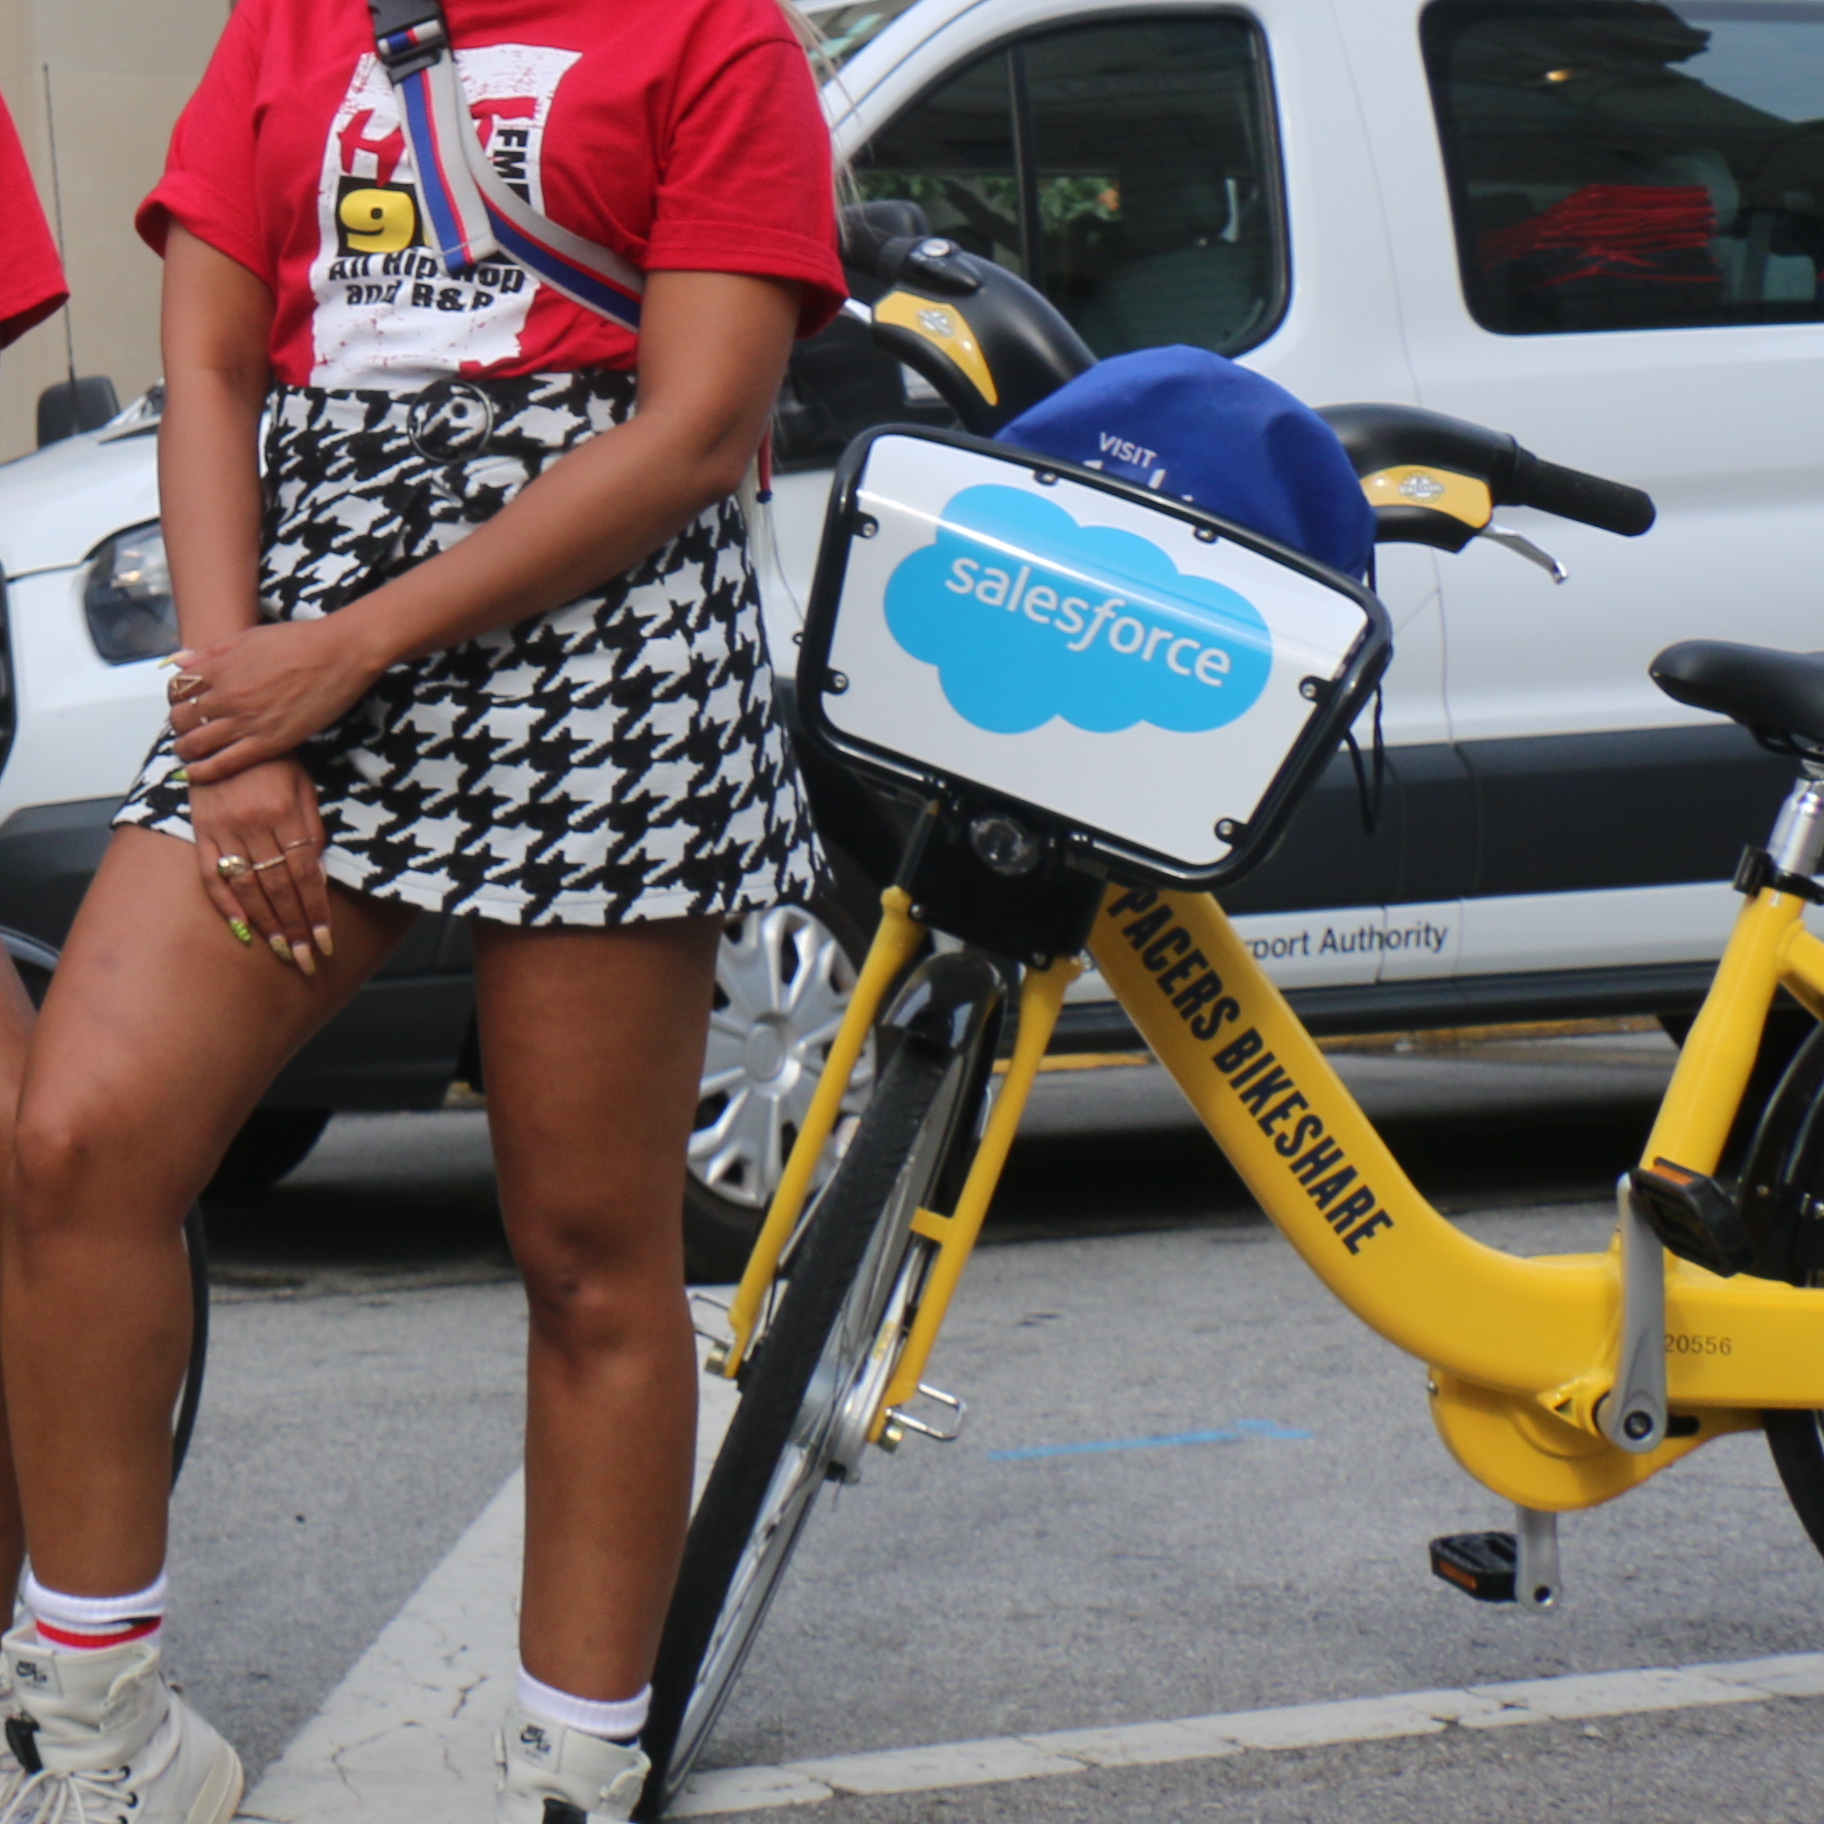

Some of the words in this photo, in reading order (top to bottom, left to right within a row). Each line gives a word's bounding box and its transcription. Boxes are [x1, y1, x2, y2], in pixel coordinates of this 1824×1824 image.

[337, 96, 538, 187] HT
[494, 129, 529, 179] FM
[329, 253, 370, 281] All
[382, 252, 438, 279] Hip
[346, 280, 403, 305] and
[1099, 431, 1158, 469] VISIT
[945, 557, 1232, 688] salesforce
[1246, 931, 1312, 960] port
[1319, 920, 1450, 956] Authority
[1107, 887, 1241, 1042] PACERS
[1211, 1026, 1394, 1255] BIKESHARE
[1664, 1333, 1733, 1356] 20556
